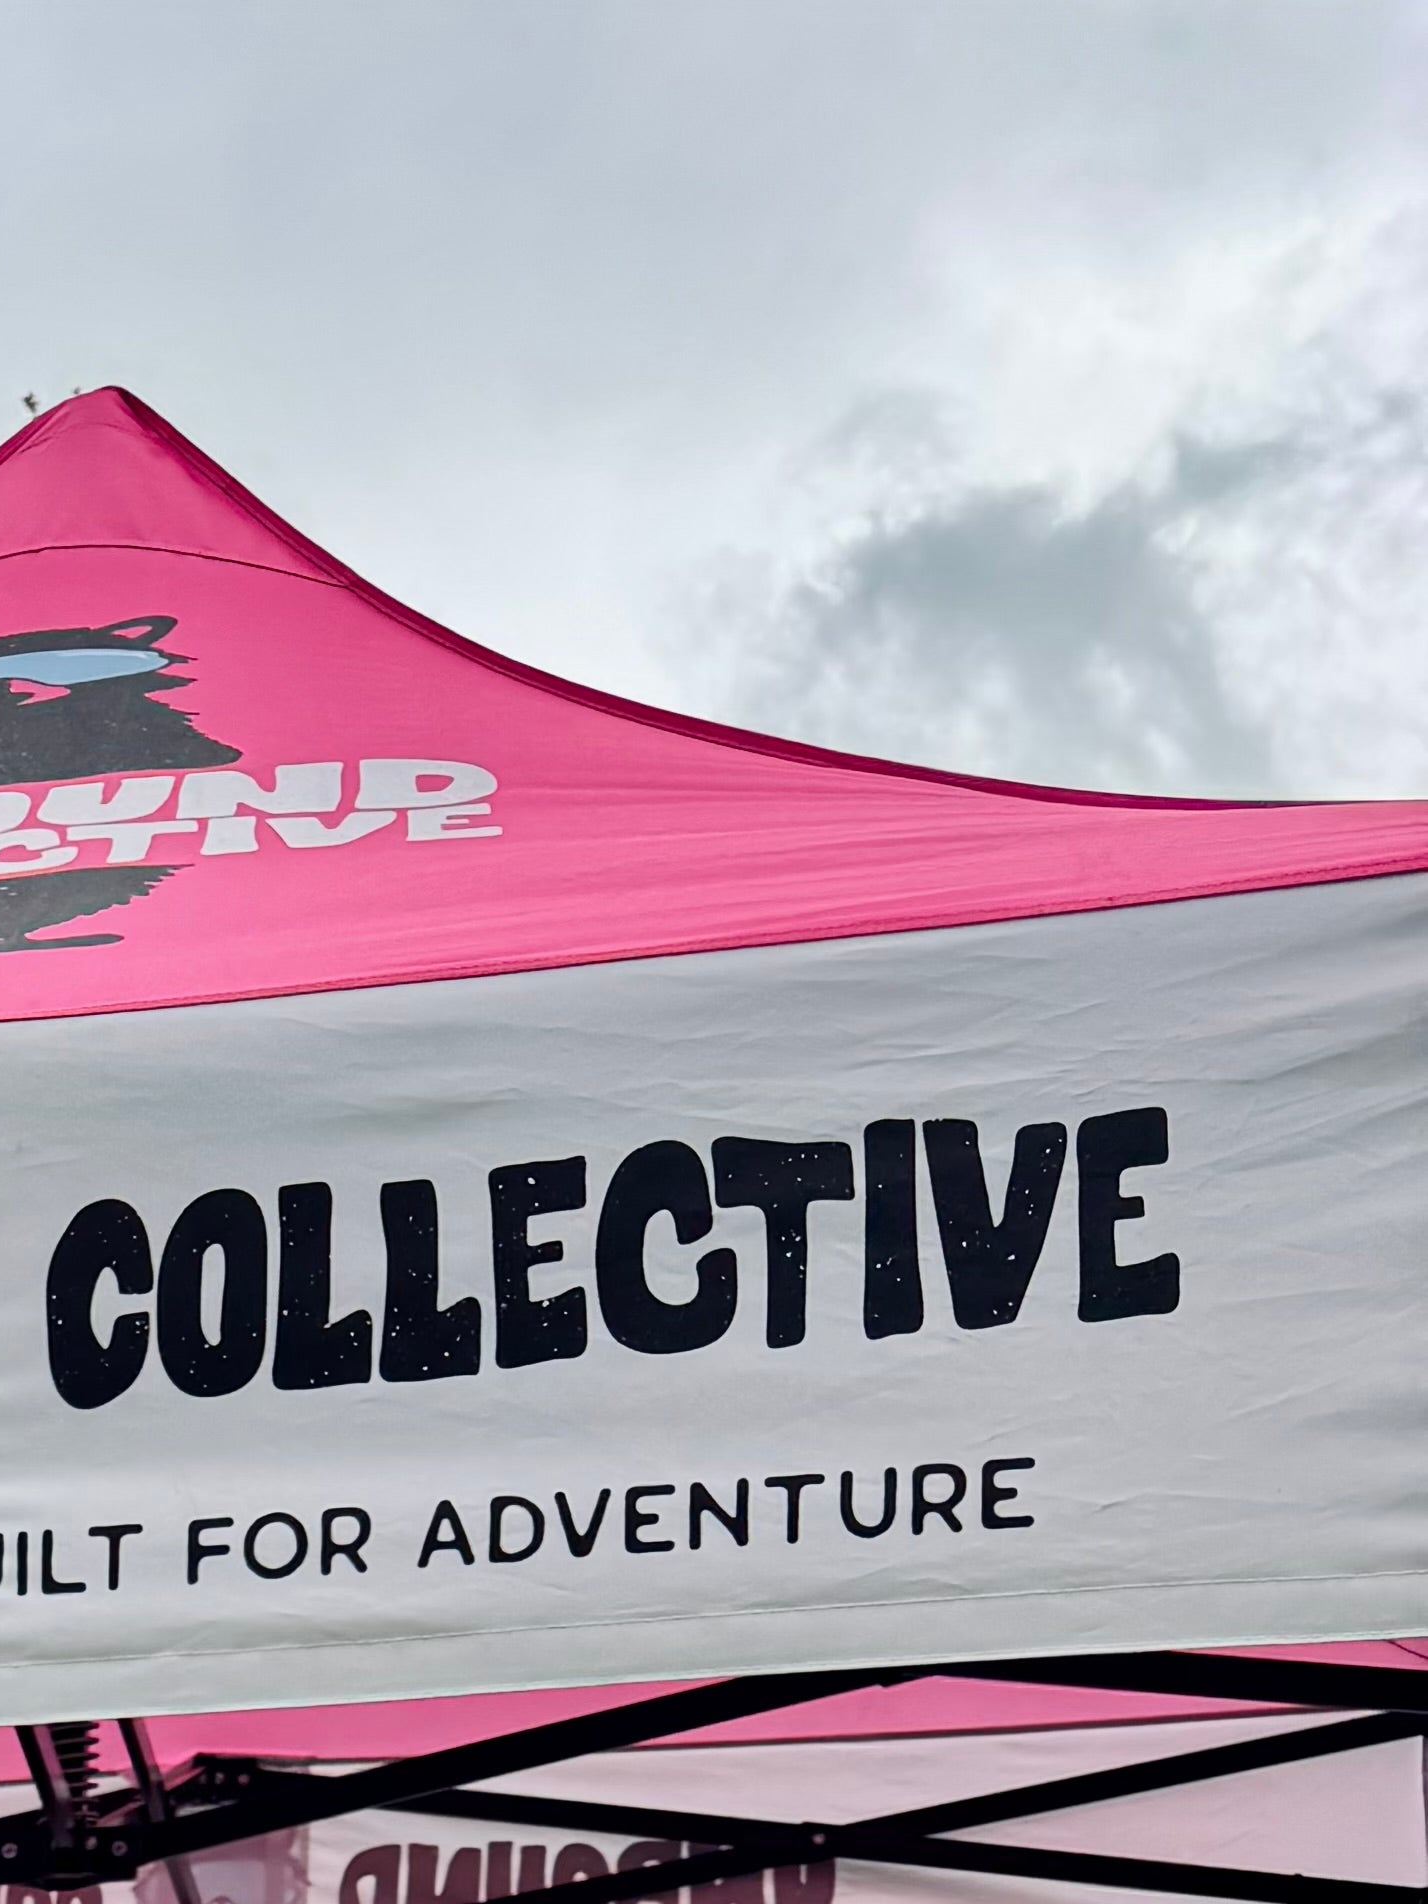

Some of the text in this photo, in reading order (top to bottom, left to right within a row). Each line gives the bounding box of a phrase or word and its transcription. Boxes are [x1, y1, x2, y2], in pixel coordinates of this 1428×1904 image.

[47, 1107, 1181, 1409] COLLECTIVE
[188, 1507, 372, 1585] FOR
[418, 1457, 1037, 1568] ADVENTURE
